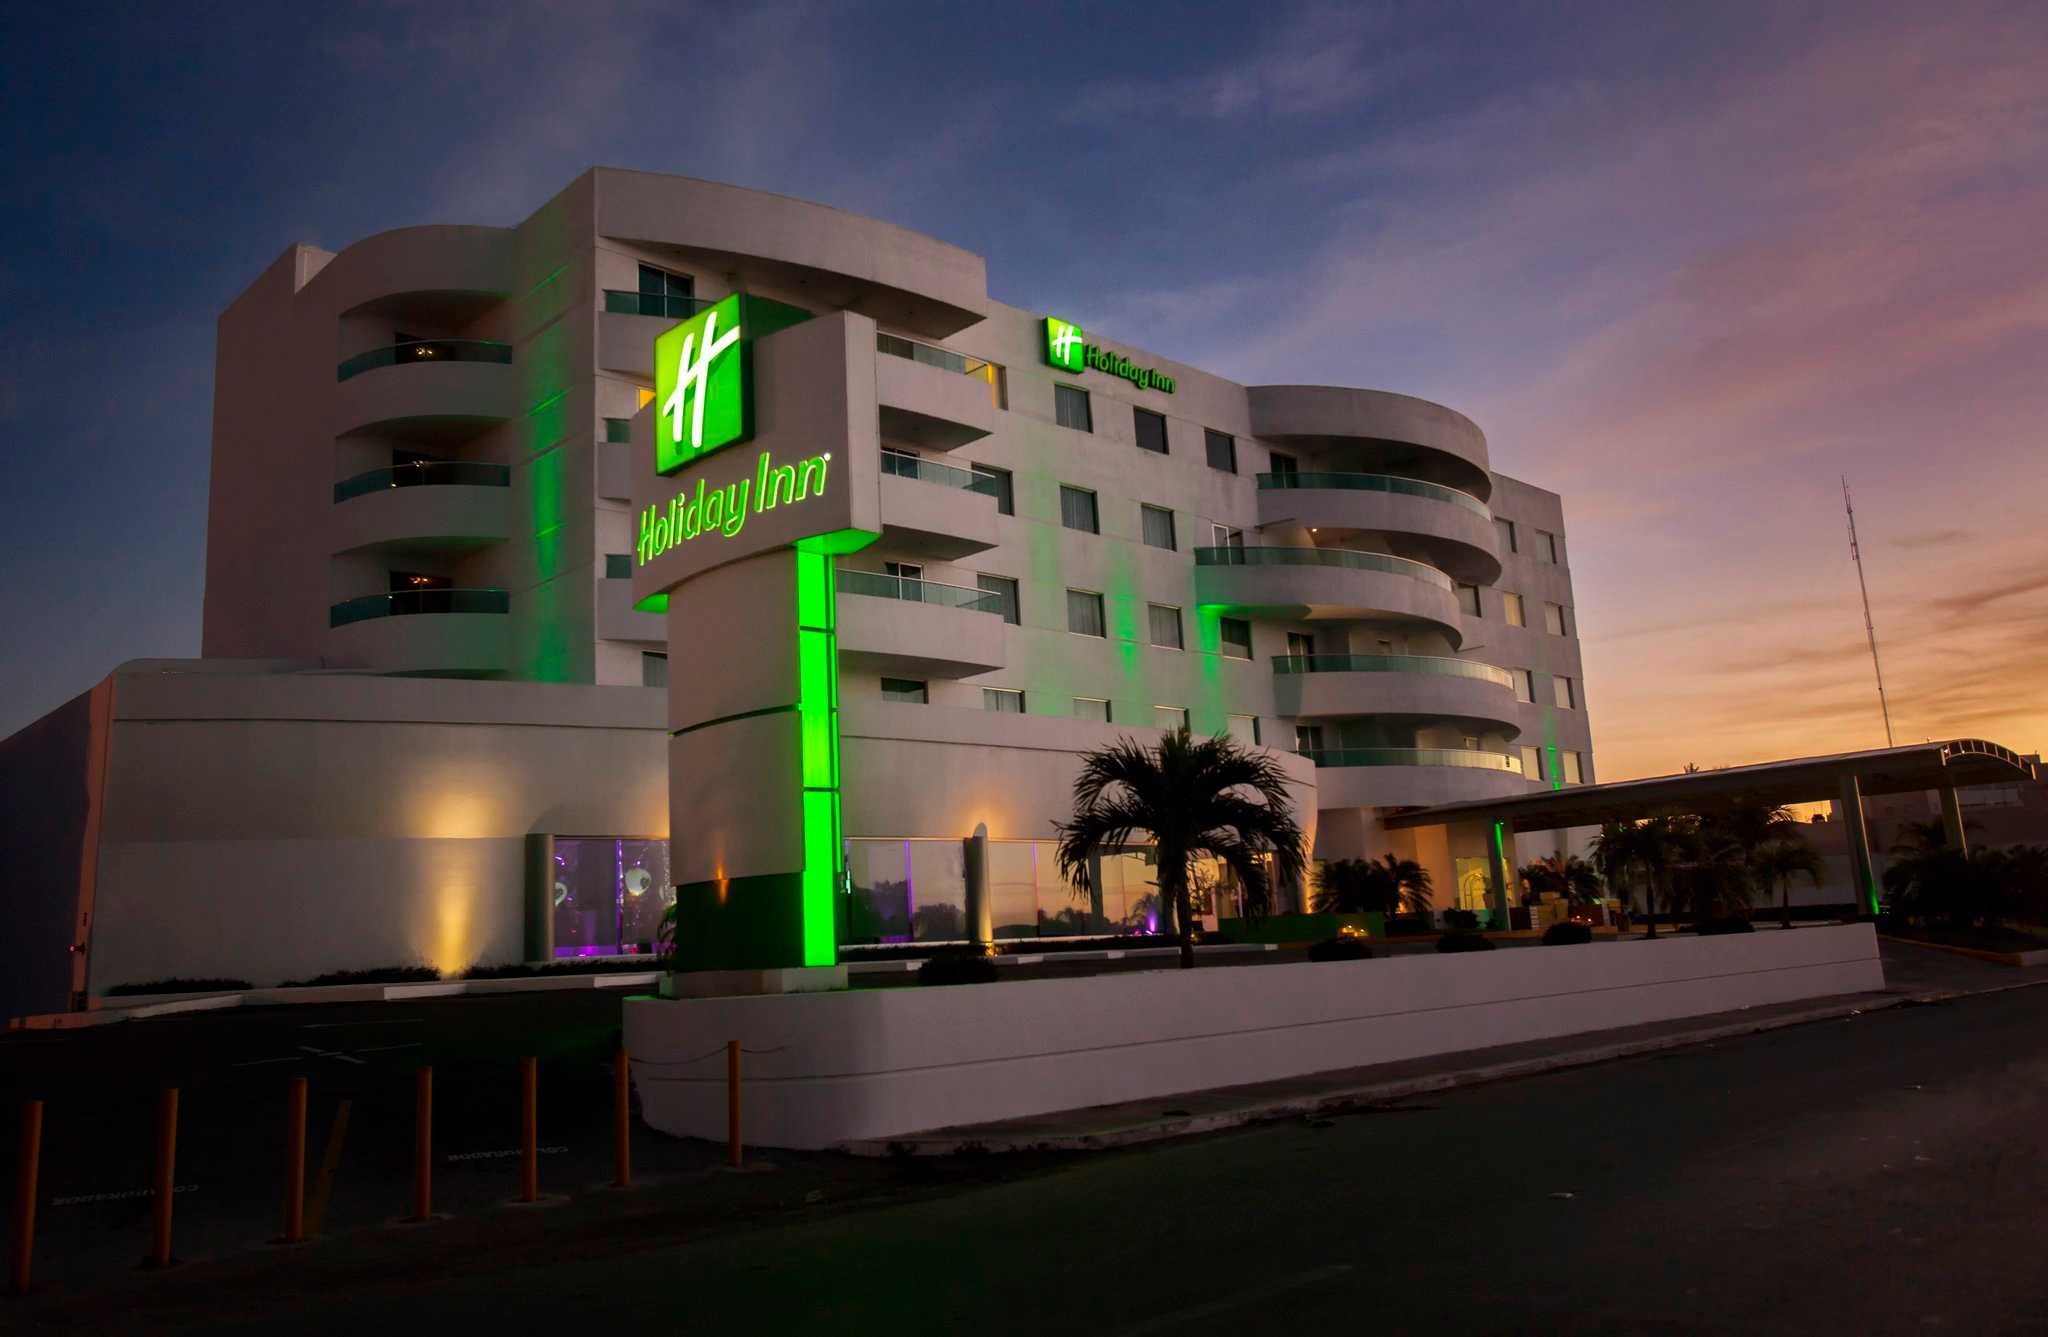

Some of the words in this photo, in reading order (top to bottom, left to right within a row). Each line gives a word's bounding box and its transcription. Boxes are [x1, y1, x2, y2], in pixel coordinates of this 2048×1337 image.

[1087, 345, 1149, 390] Holiday
[1151, 368, 1176, 394] Inn
[637, 478, 750, 567] Holiday
[754, 452, 827, 513] Inn
